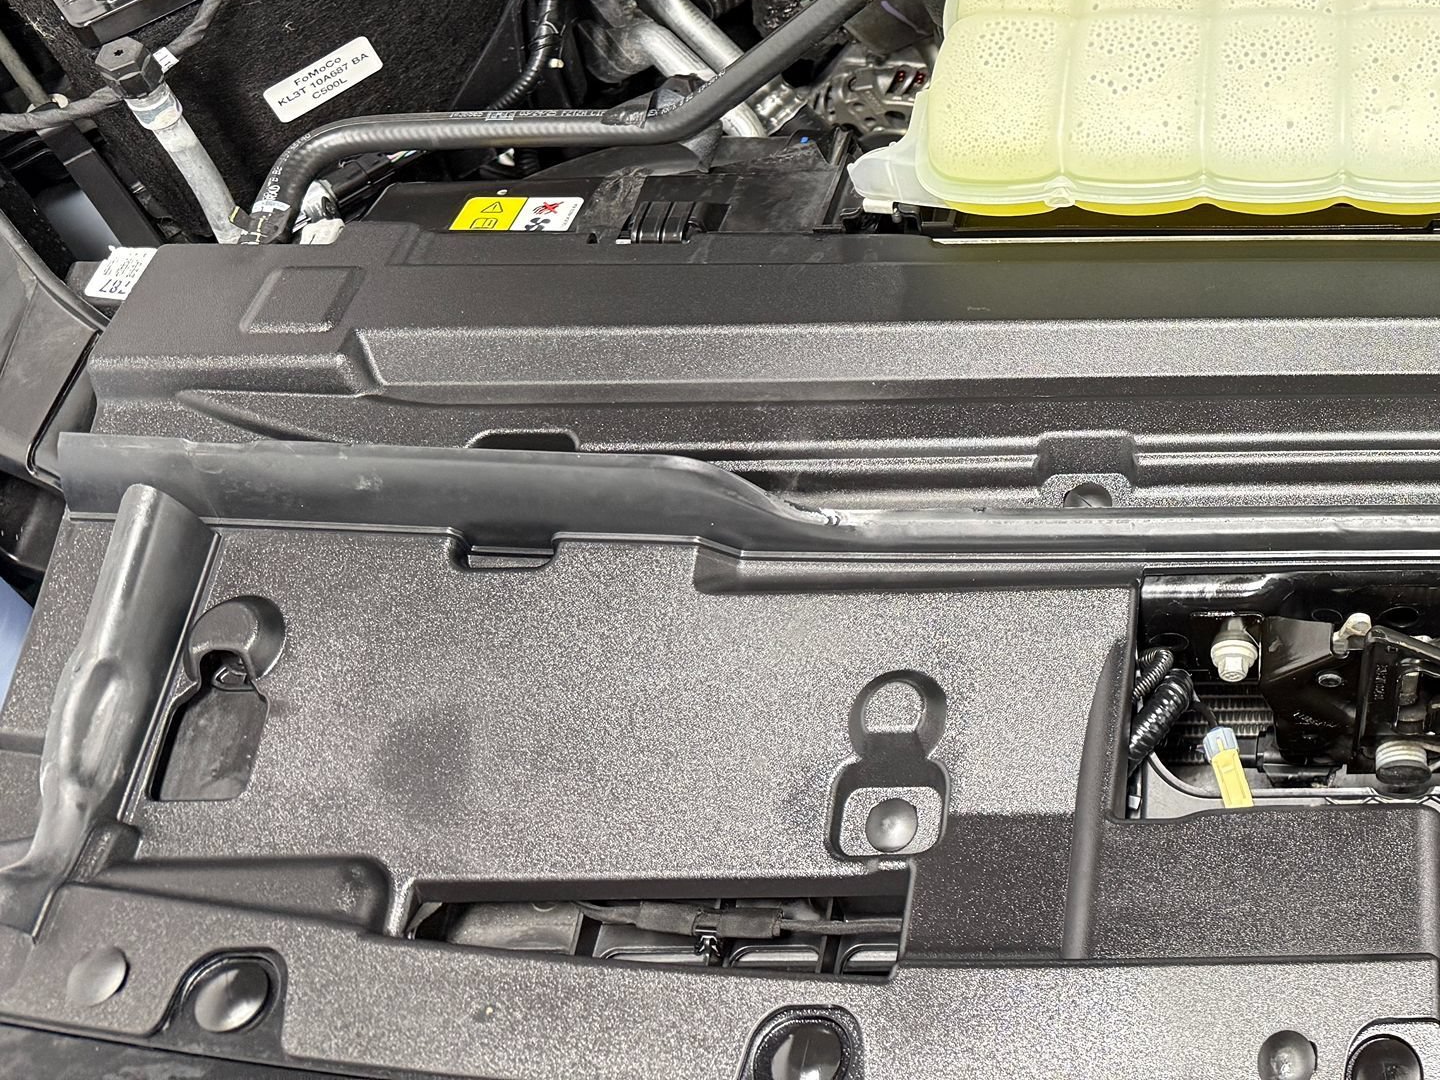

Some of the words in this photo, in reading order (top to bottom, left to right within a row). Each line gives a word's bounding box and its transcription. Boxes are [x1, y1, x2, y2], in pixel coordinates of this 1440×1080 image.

[277, 86, 307, 107] KL3T
[310, 63, 348, 89] 10A687
[351, 53, 369, 65] BA
[294, 57, 342, 86] FoMoCo
[312, 78, 348, 99] C500L
